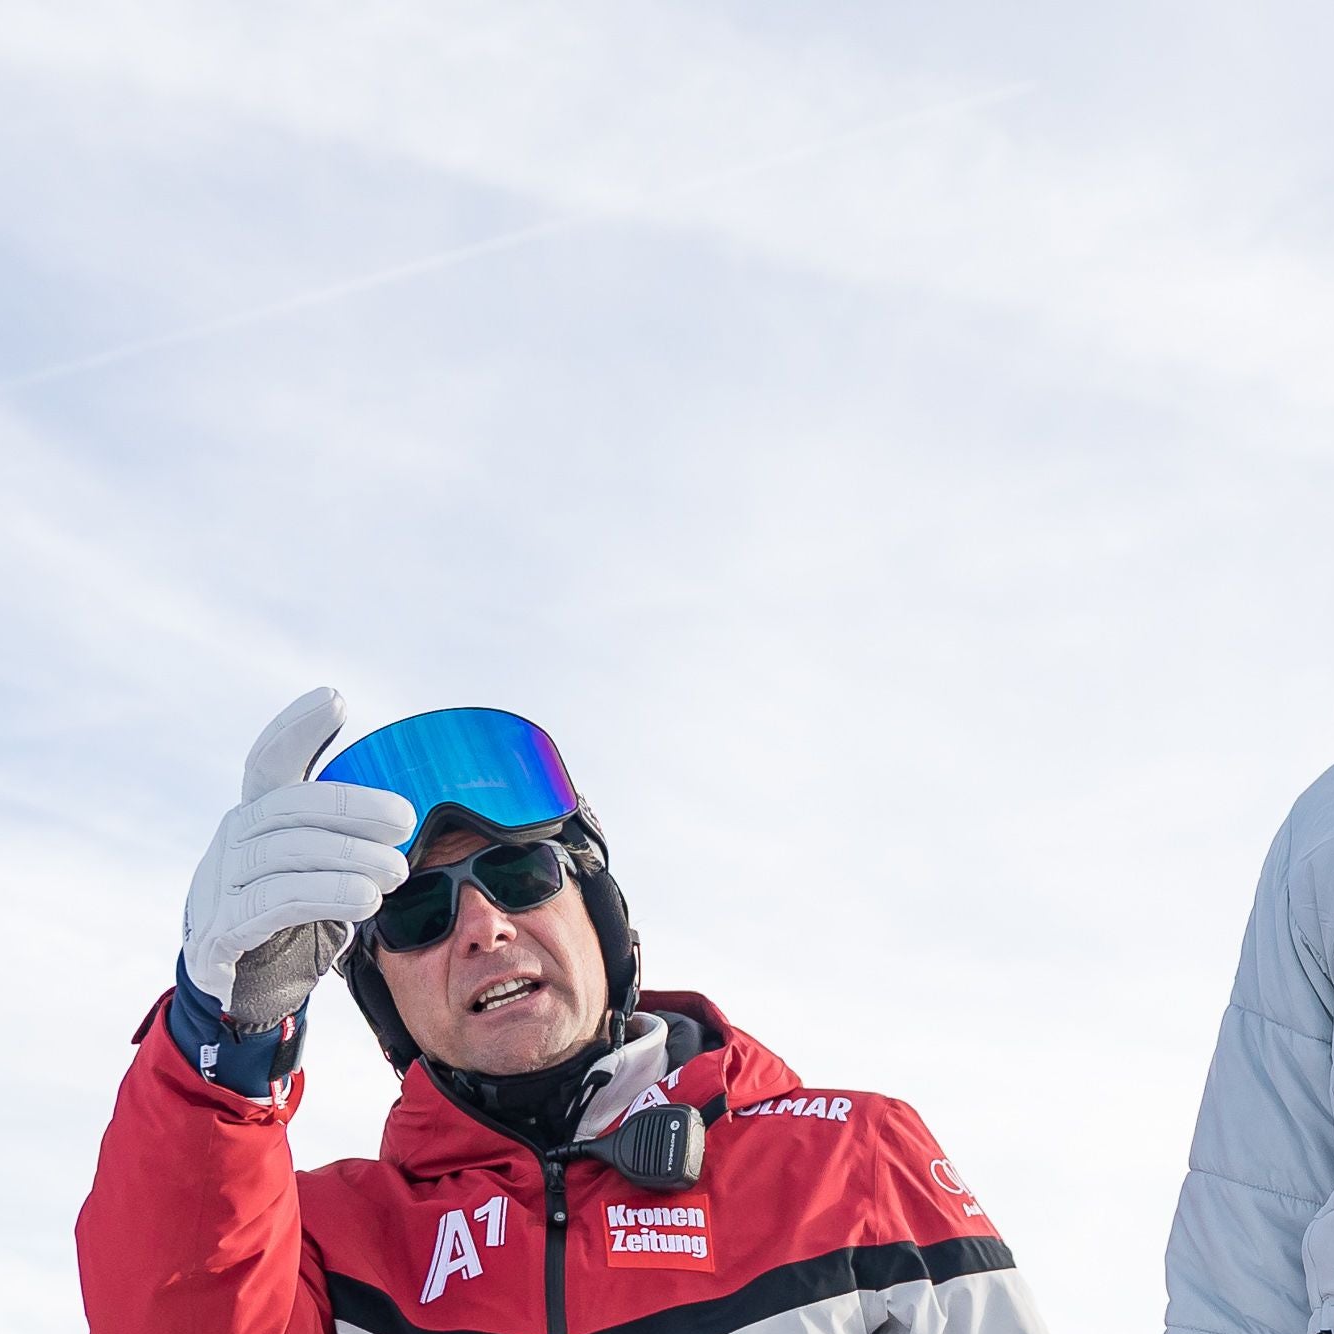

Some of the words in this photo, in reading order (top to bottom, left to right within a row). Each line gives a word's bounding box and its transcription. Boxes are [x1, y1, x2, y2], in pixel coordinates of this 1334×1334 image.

[668, 1132, 676, 1172] MOTOROLA
[606, 1204, 706, 1229] Kronen
[419, 1195, 509, 1305] A1
[609, 1227, 708, 1259] Zeitung
